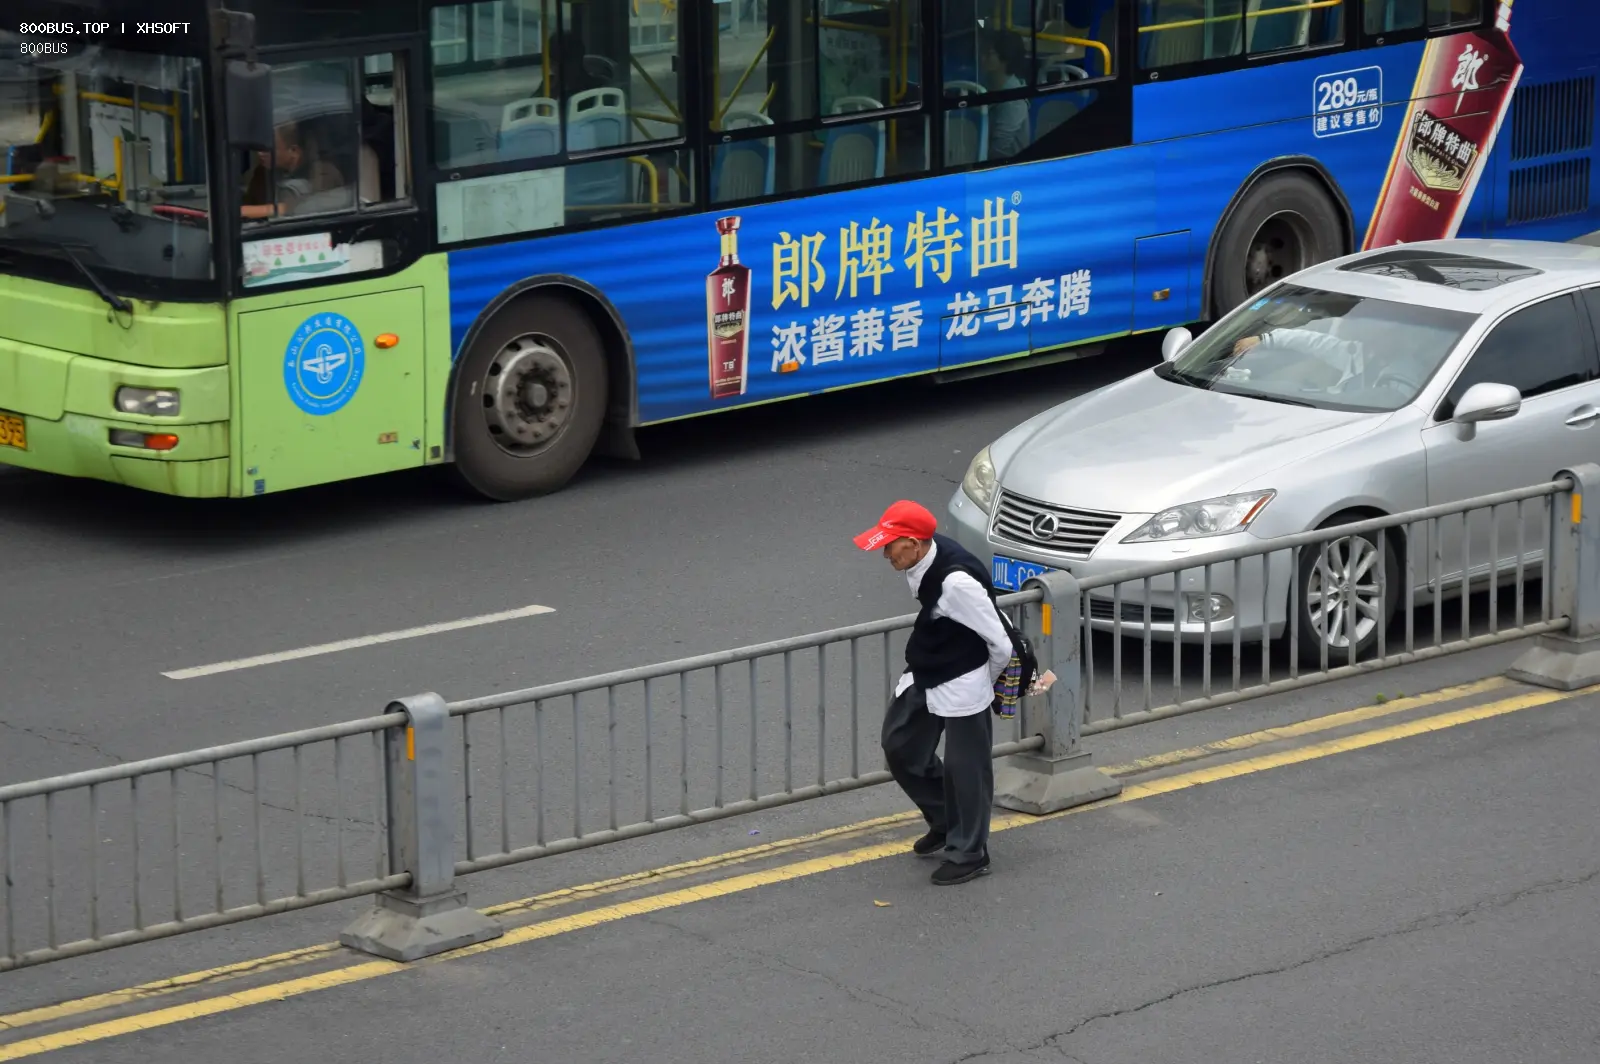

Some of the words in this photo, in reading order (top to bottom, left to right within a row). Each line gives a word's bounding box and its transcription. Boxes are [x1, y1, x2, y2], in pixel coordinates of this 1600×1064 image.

[1316, 107, 1380, 132] 建议零售价
[1417, 114, 1472, 163] 郎牌特曲
[770, 299, 924, 373] 浓酱兼香
[945, 268, 1093, 341] 龙马奔腾
